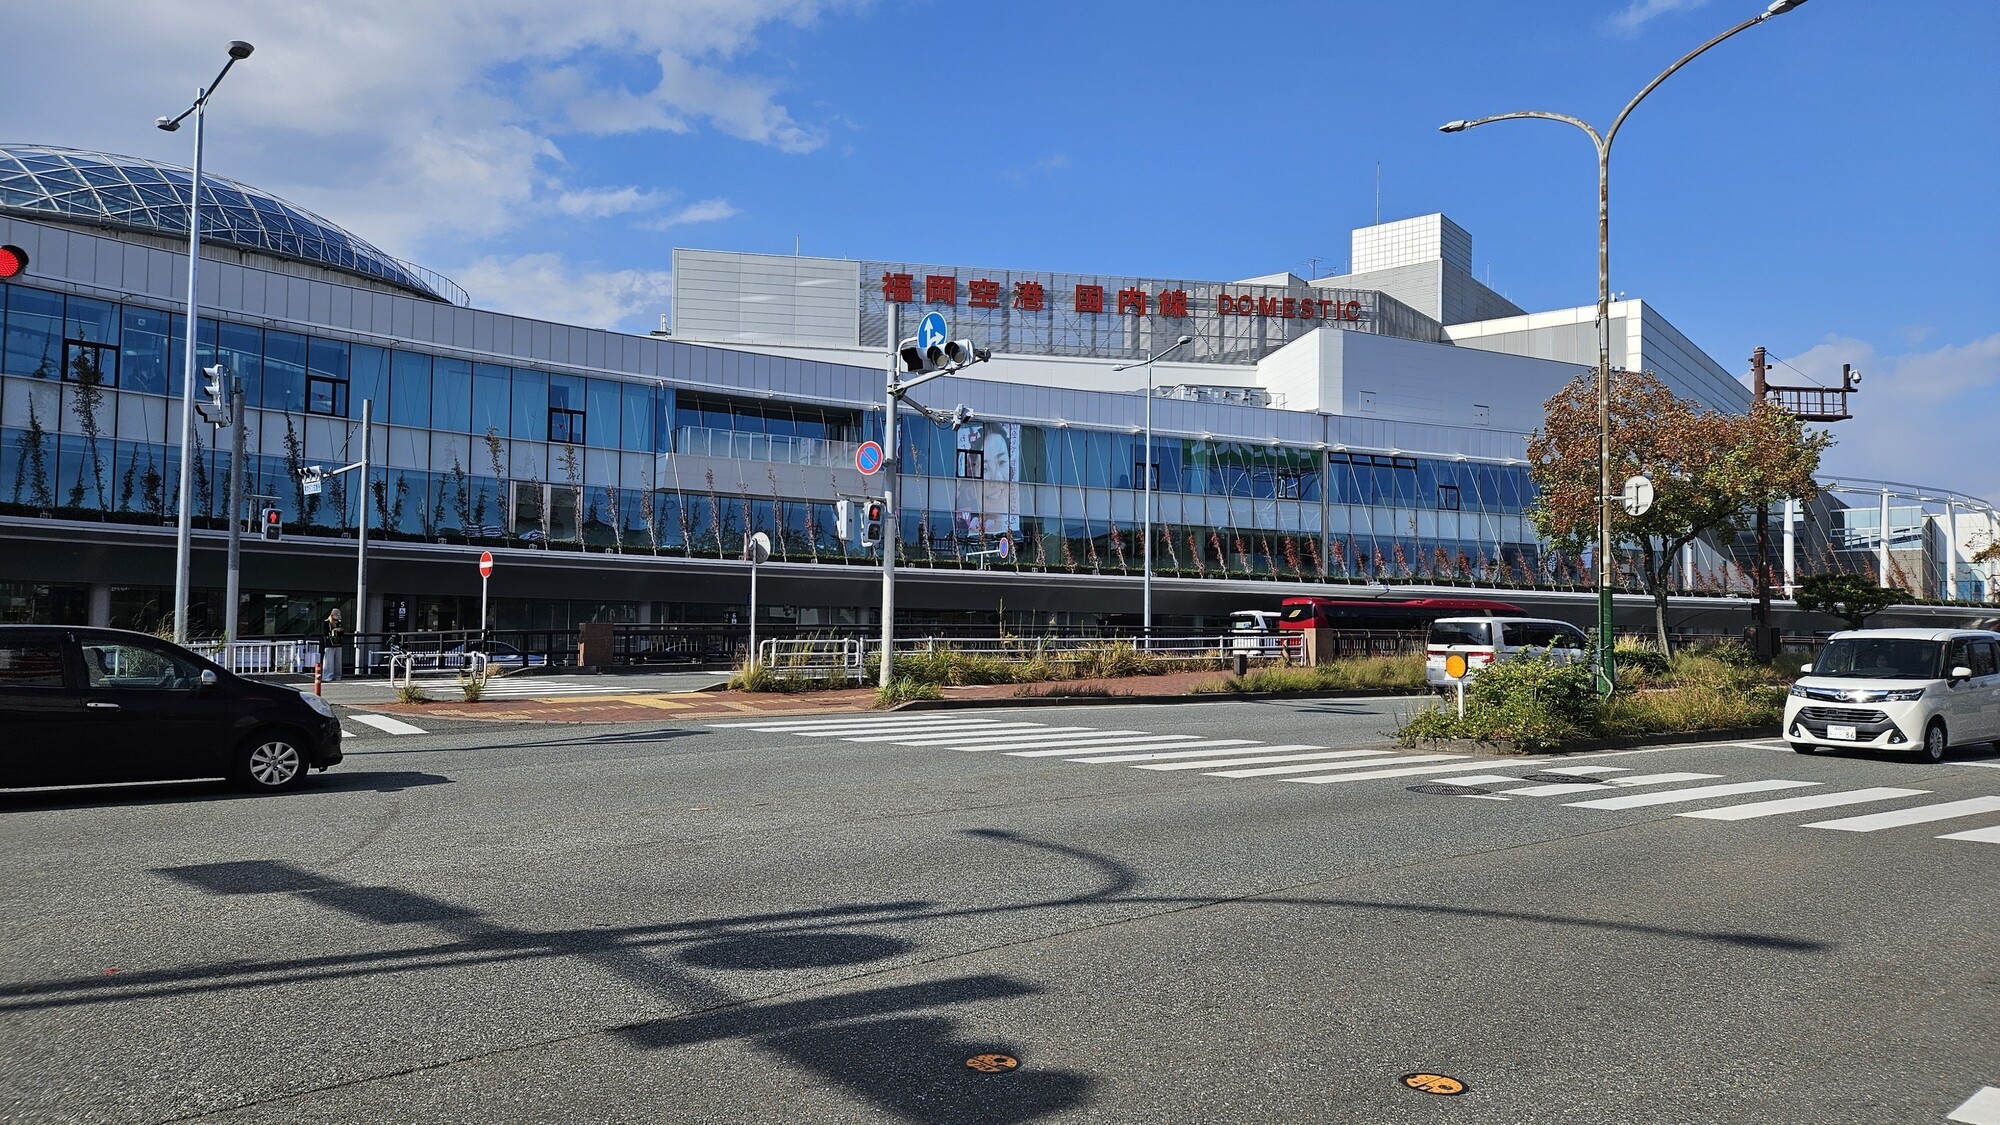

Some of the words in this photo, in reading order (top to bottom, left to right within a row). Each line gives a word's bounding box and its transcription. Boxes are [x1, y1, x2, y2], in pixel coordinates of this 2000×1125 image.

[882, 272, 1044, 311] 福岡空港
[1075, 284, 1189, 318] 国内線
[1217, 293, 1362, 321] DOMESTIC
